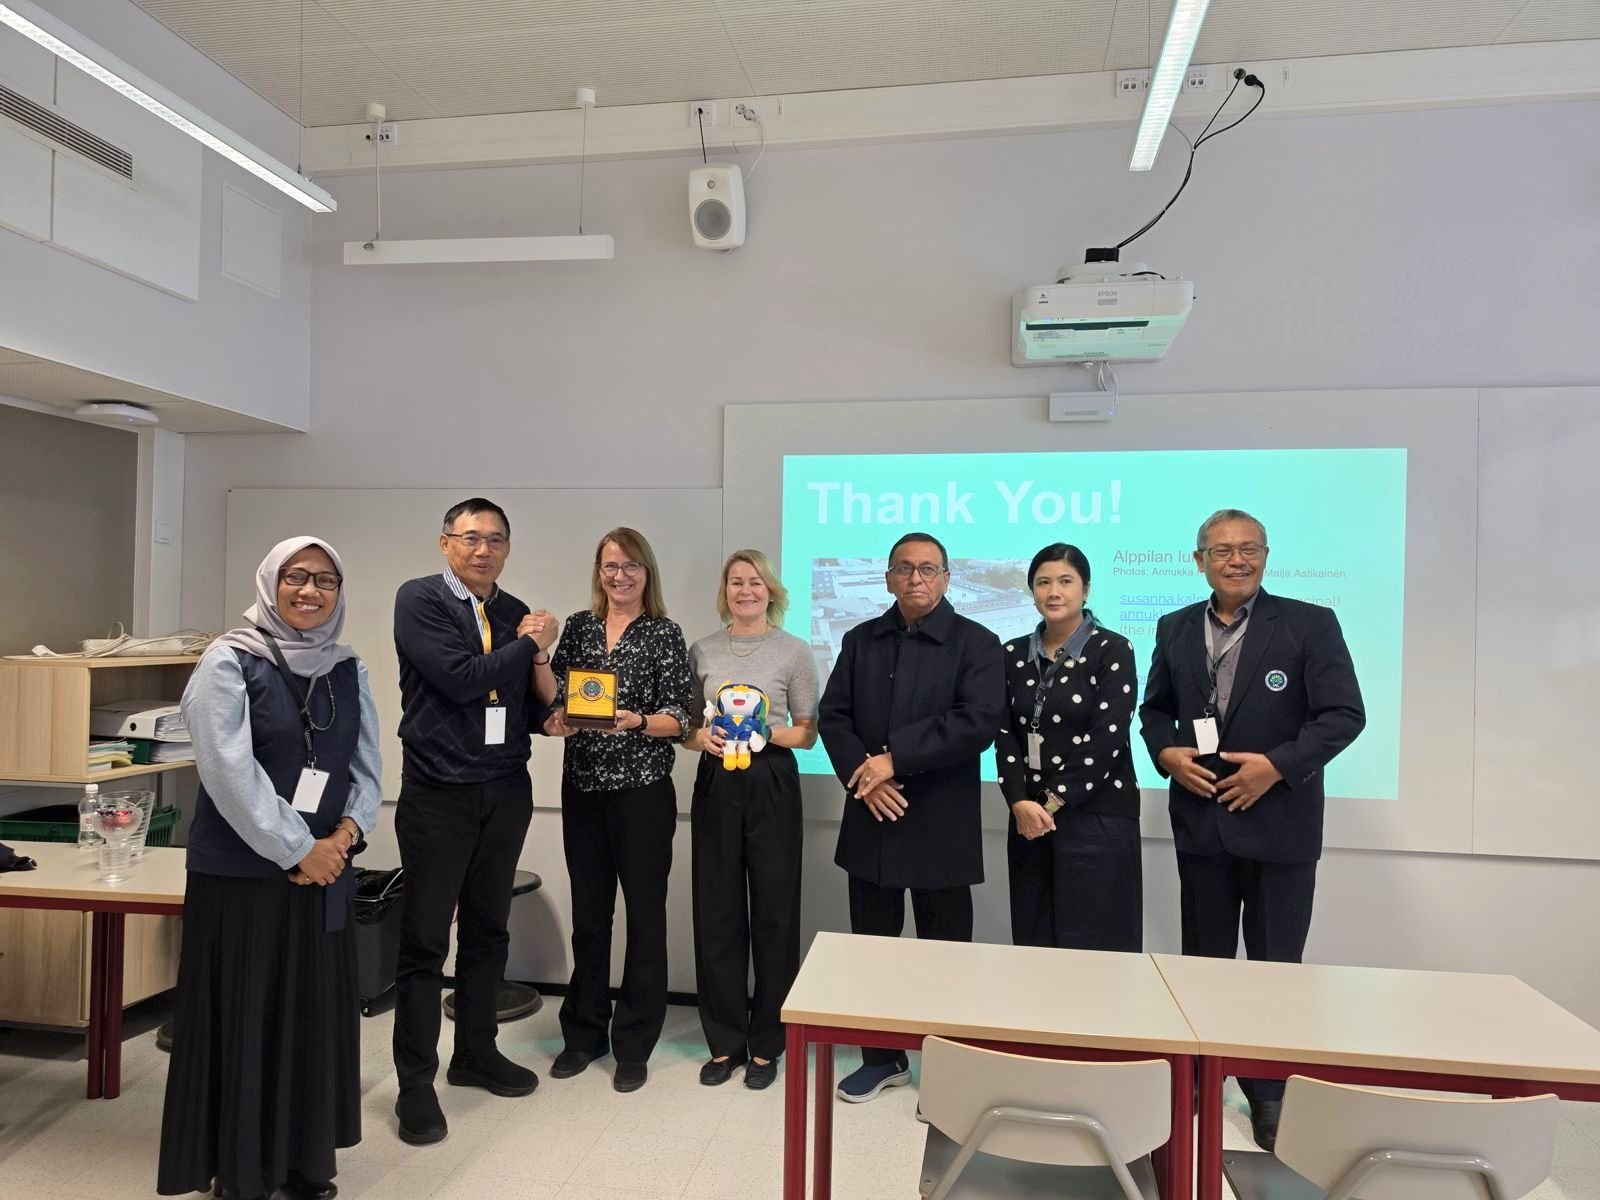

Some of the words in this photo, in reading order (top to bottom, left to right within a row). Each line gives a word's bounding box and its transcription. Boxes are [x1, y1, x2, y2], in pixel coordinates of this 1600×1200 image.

[806, 480, 976, 525] Thank
[995, 479, 1122, 525] You!
[1113, 549, 1173, 566] Alppilan
[1178, 550, 1195, 563] lu
[1113, 567, 1149, 576] Photos:
[1151, 567, 1194, 577] Annukka
[1293, 569, 1346, 578] Astikainen
[1119, 623, 1145, 635] (the
